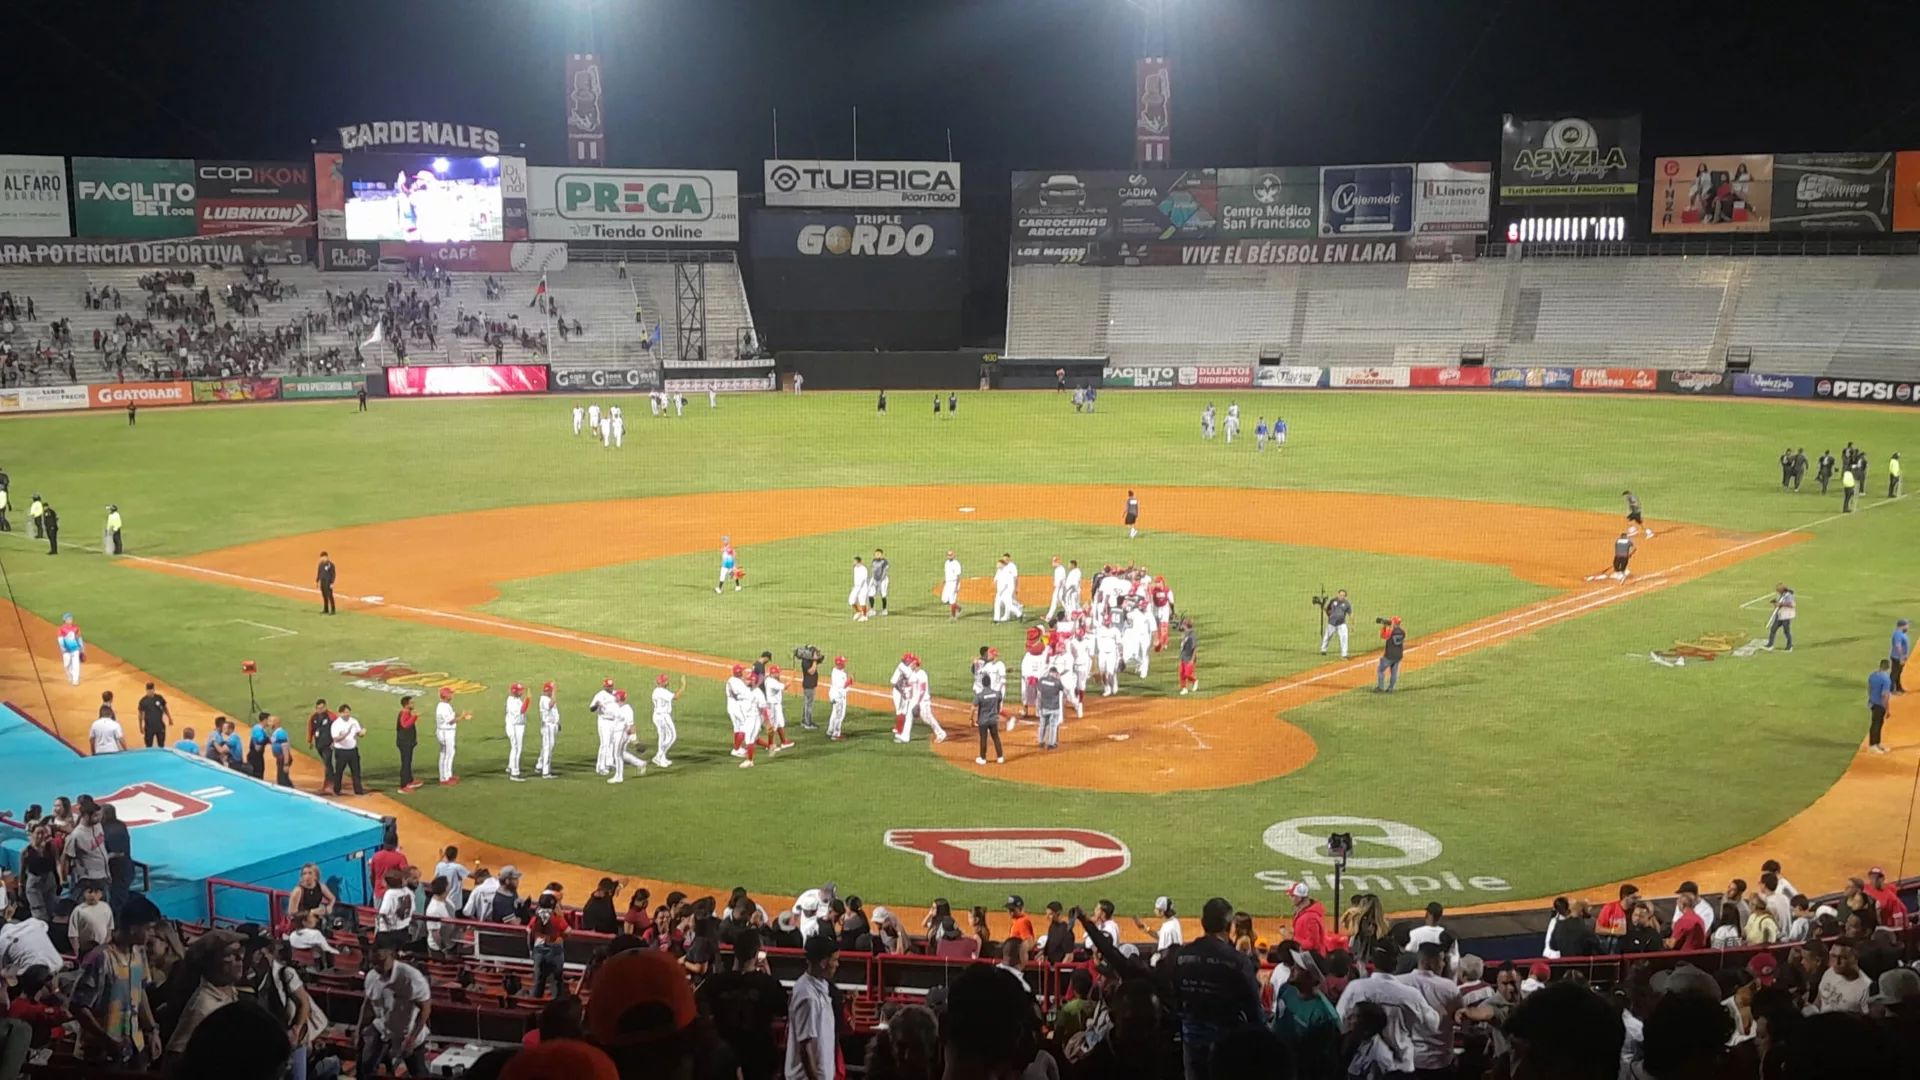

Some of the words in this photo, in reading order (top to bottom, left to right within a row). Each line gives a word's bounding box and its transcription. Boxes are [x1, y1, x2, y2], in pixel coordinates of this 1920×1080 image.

[338, 120, 500, 153] CARDENALES
[4, 174, 61, 191] ALFARO
[803, 169, 956, 190] TUBRICA
[78, 181, 196, 201] FACILITO
[566, 182, 703, 214] PRECA
[1118, 187, 1157, 198] CADIPA
[203, 206, 297, 220] LUBRIKON
[1223, 205, 1263, 217] Centro
[1267, 204, 1311, 217] Médico
[855, 214, 902, 225] TRIPLE
[1223, 217, 1246, 229] San
[1250, 217, 1311, 229] Francisco
[592, 224, 646, 238] Tienda
[652, 225, 703, 239] Online
[797, 224, 934, 256] GORDO
[36, 244, 133, 264] POTENCIA
[138, 244, 244, 264] DEPORTIVA
[1017, 248, 1040, 256] LOS
[1182, 246, 1220, 264] VIVE
[1223, 245, 1243, 264] EL
[1247, 238, 1319, 263] BÉISBOL
[1323, 244, 1347, 262] EN
[1351, 243, 1397, 262] LARA
[1103, 367, 1174, 379] FACILITO
[1199, 367, 1251, 376] DIABLITOS
[1199, 376, 1251, 384] UNDERWOOD
[113, 388, 182, 401] GATORADE
[1832, 380, 1894, 400] PEPSI
[1254, 869, 1511, 896] Simple
